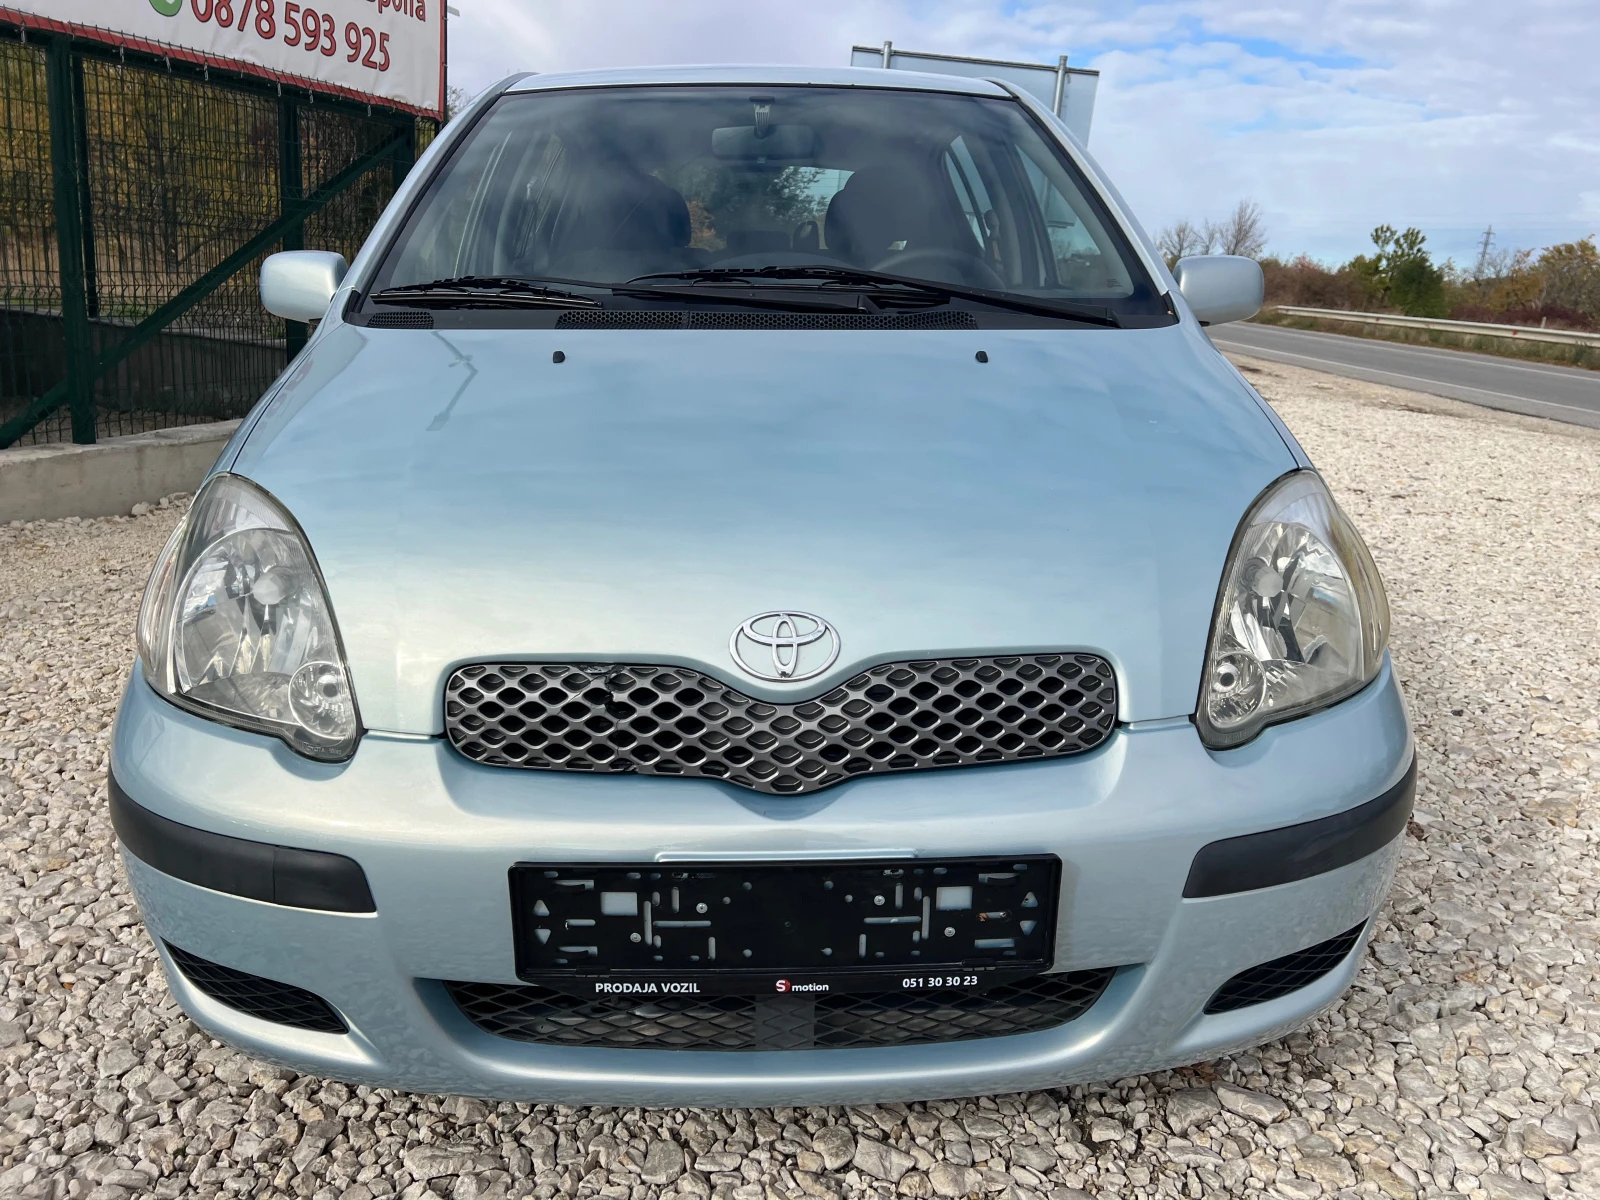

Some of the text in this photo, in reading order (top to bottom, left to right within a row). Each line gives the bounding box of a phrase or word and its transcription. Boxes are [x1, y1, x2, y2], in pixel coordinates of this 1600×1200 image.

[284, 1, 337, 56] 593
[345, 22, 390, 72] 925
[792, 982, 829, 992] motion
[902, 975, 978, 988] 051 30 30 23
[595, 983, 700, 993] PRODAJA VOZIL
